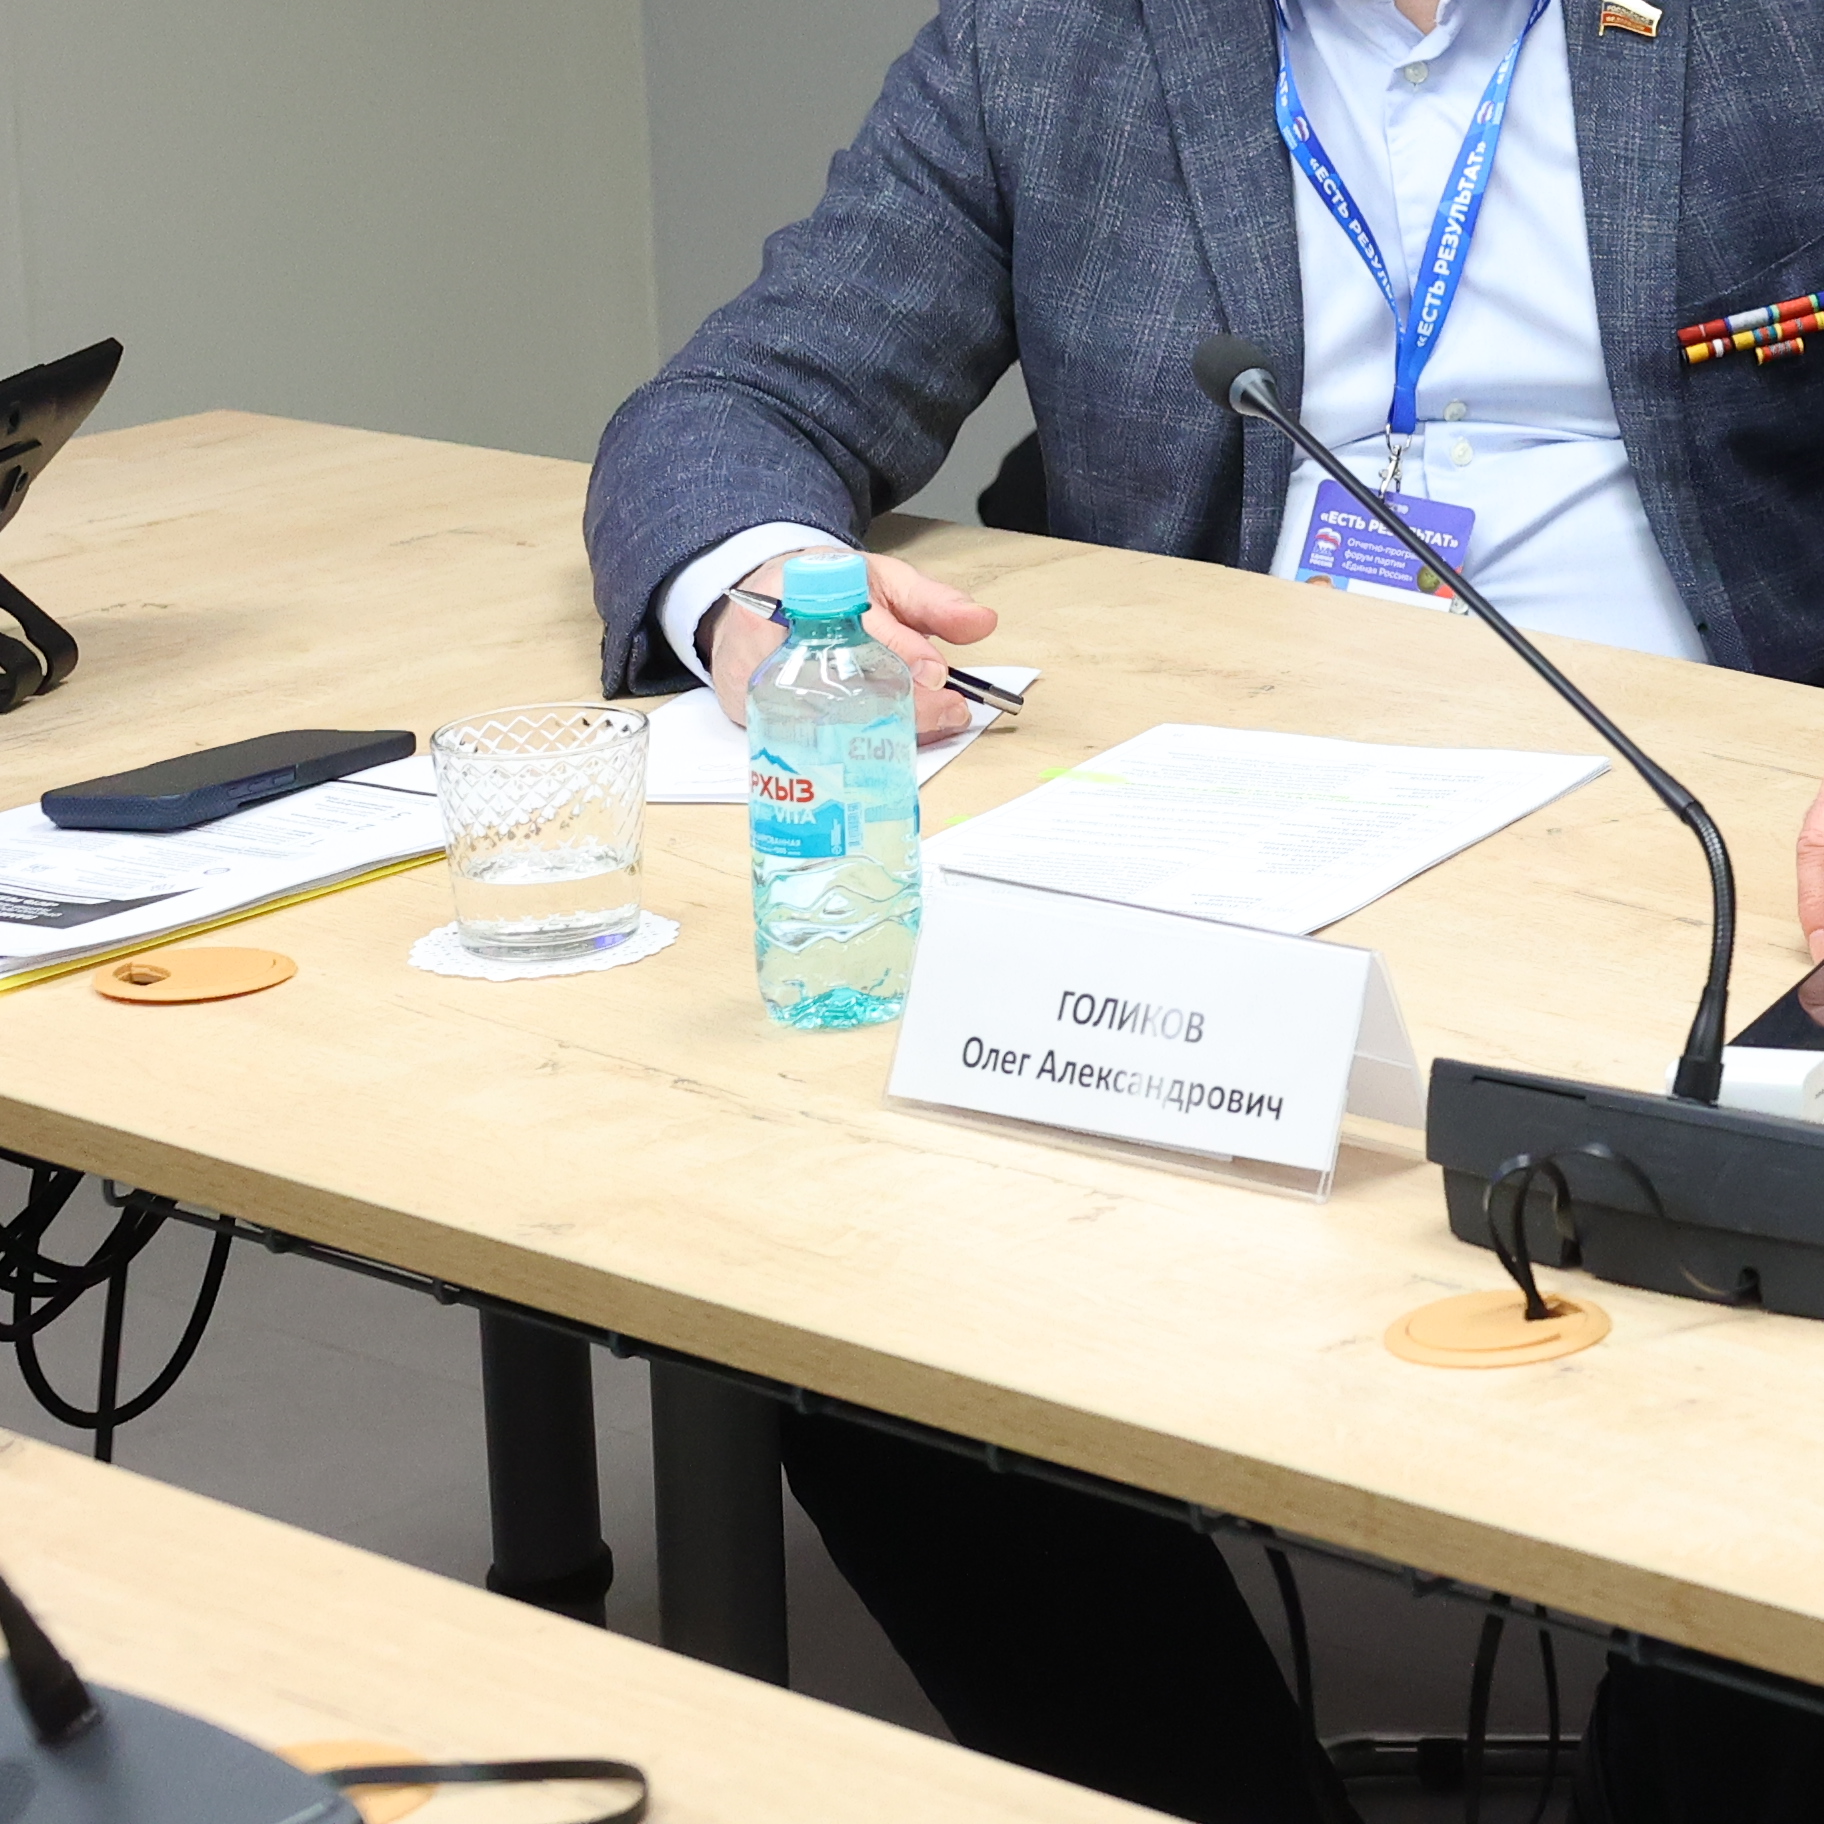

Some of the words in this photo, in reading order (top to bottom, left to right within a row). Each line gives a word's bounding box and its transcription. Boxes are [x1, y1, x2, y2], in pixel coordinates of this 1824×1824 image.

[1309, 156, 1350, 219] «ЕСТЬ
[1416, 280, 1447, 350] «ЕСТЬ
[1434, 138, 1488, 278] РЕЗУЛЬТАТ»
[1320, 510, 1366, 529] «ЕСТЬ
[750, 769, 815, 804] РХЫЗ
[1057, 989, 1206, 1044] ГОЛИКОВ
[961, 1035, 1032, 1080] Олег
[1036, 1048, 1285, 1122] Александрович
